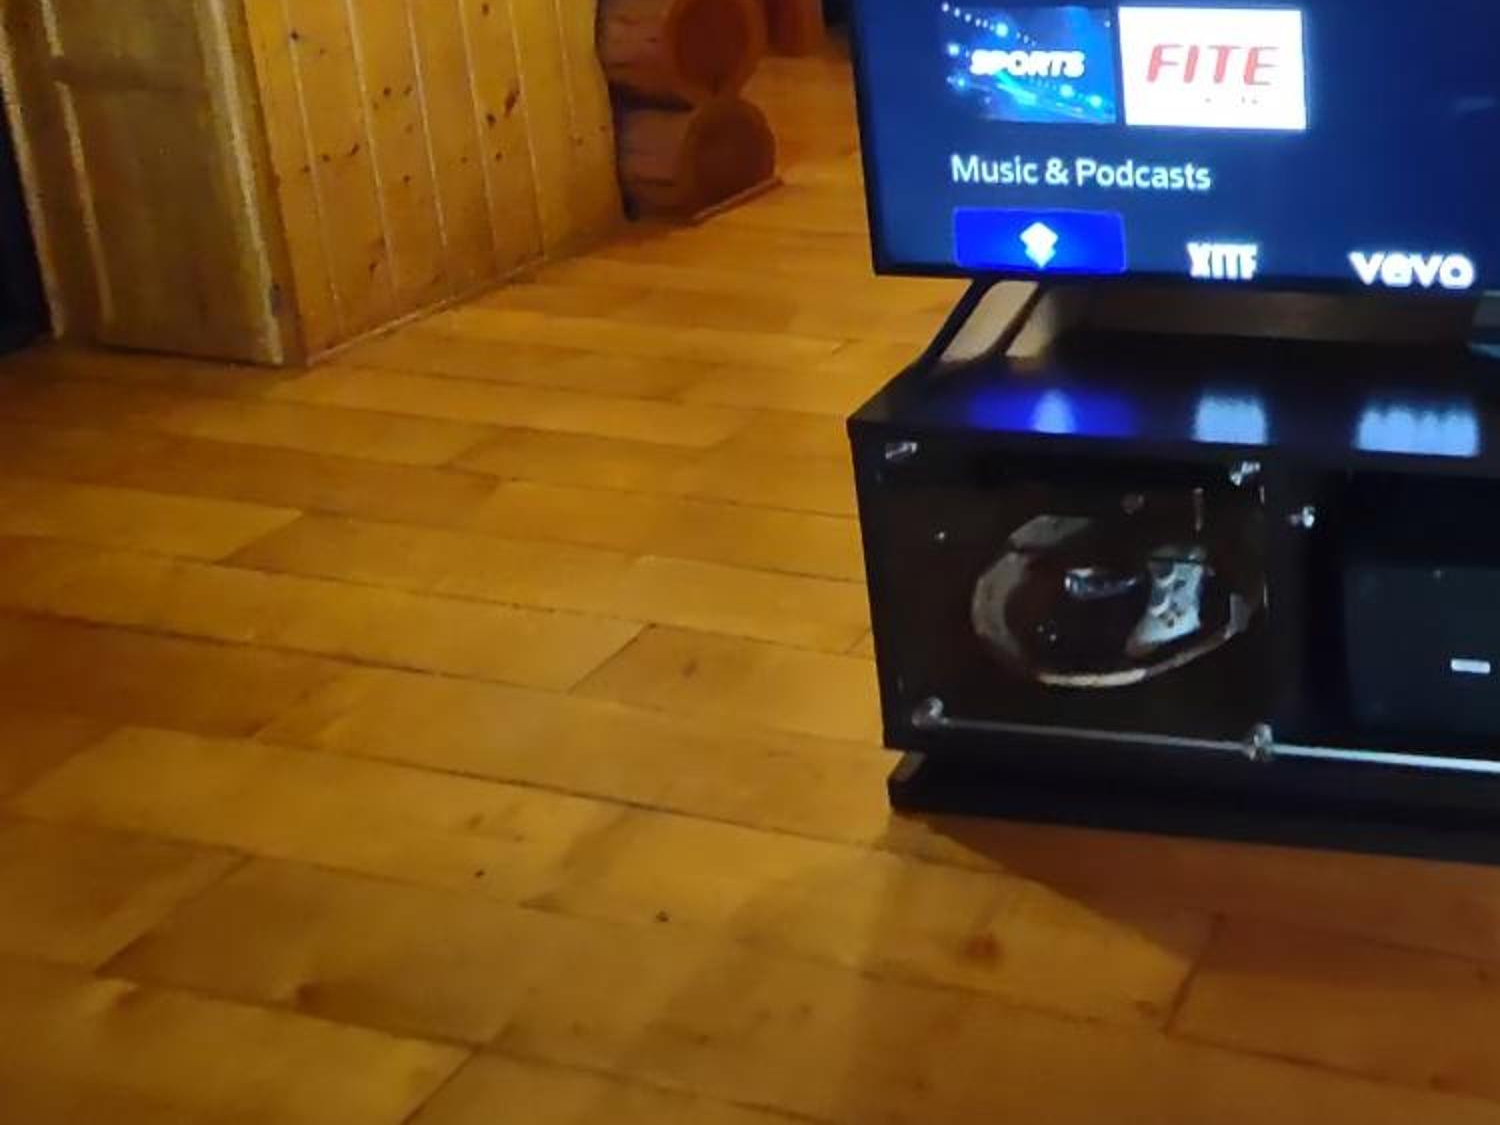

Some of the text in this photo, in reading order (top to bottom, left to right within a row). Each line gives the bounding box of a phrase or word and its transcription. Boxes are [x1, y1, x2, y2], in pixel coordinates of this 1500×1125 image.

[970, 49, 1085, 77] SPORTS
[1145, 43, 1282, 86] FITE
[951, 154, 1212, 190] Music & Podcasts
